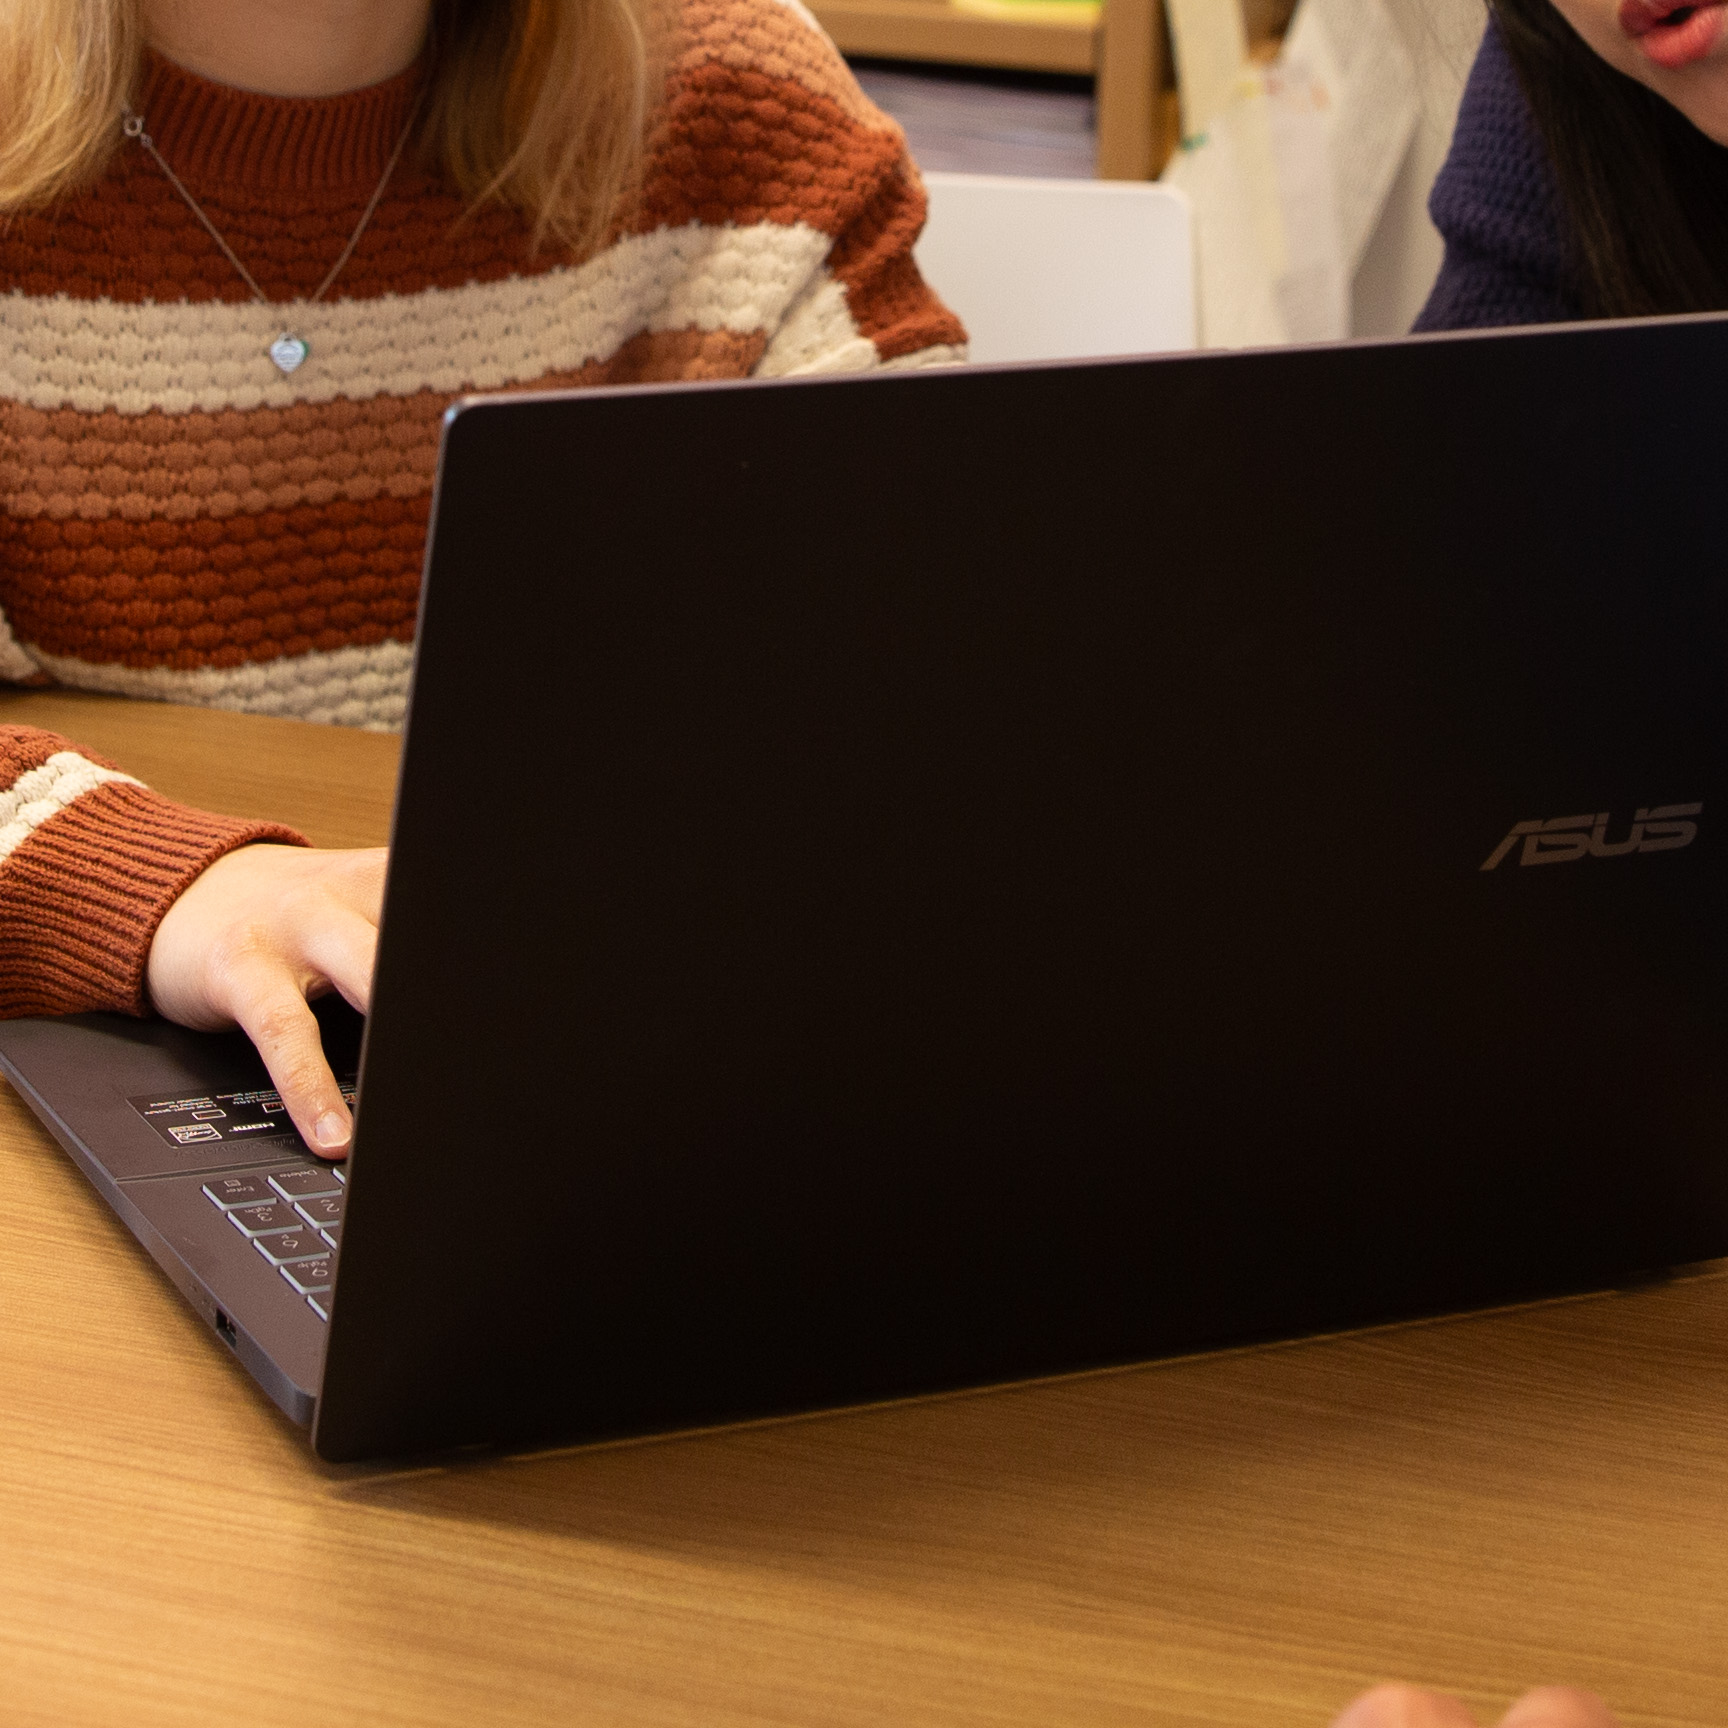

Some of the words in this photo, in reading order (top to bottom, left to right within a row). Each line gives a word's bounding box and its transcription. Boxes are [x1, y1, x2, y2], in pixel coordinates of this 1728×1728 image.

[1479, 802, 1703, 871] ASUS
[233, 1122, 275, 1132] HDMI
[280, 1169, 318, 1178] Delete
[226, 1185, 254, 1193] Enter
[244, 1206, 272, 1214] PgDn
[327, 1202, 339, 1212] 2
[257, 1212, 273, 1222] 3
[282, 1239, 299, 1249] 6
[297, 1260, 327, 1269] PgUp
[312, 1266, 328, 1277] 9
